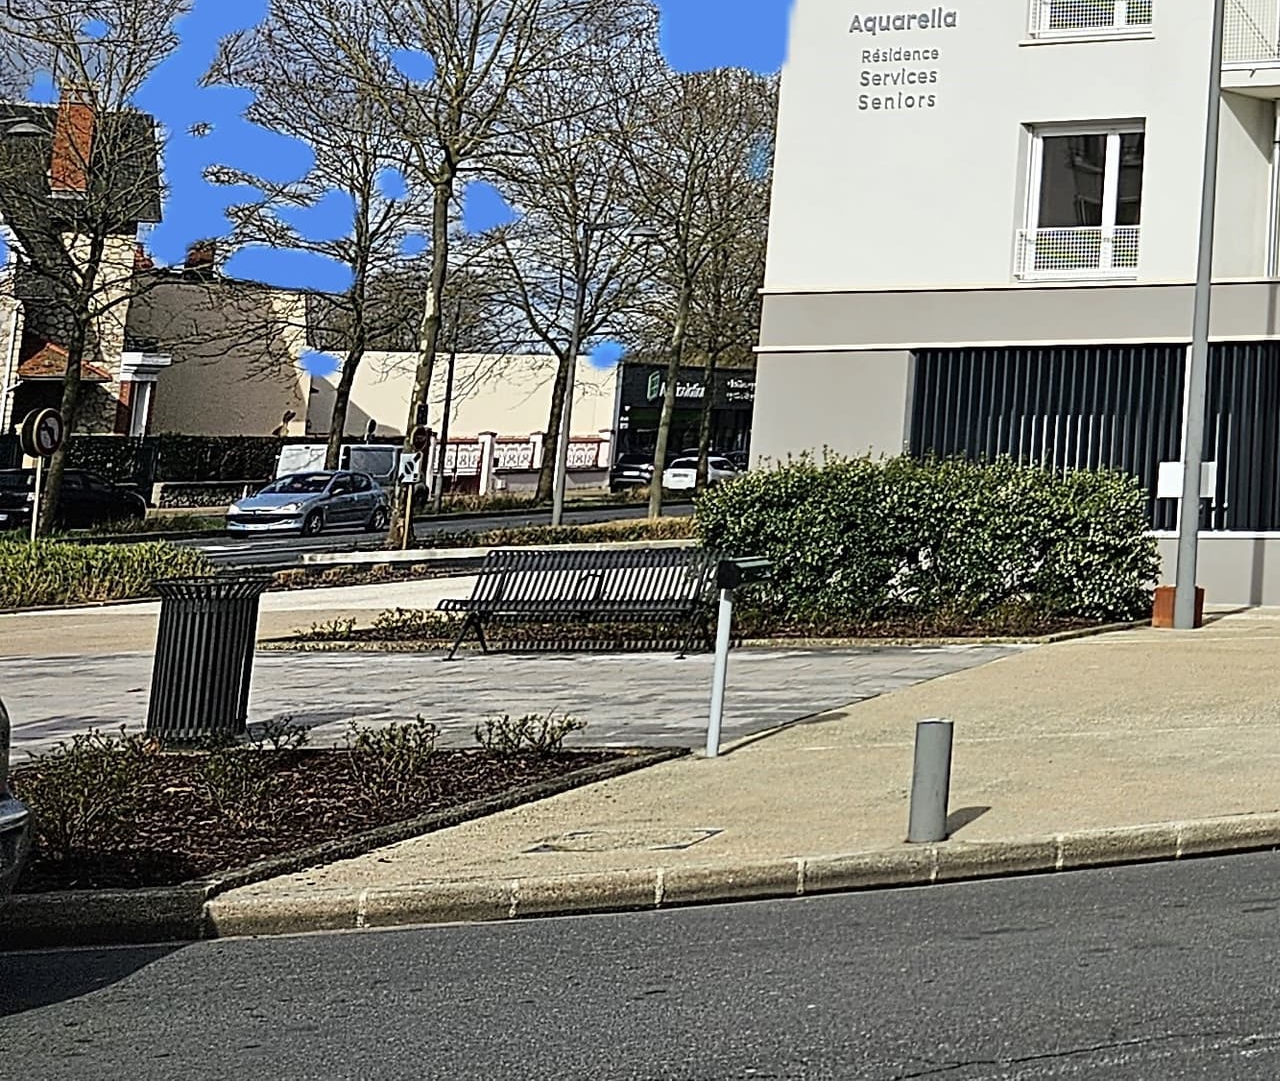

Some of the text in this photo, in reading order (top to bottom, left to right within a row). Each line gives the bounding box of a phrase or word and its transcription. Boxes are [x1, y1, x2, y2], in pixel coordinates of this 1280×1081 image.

[861, 47, 940, 63] Résidence
[859, 67, 938, 87] Services
[858, 91, 936, 110] Seniors
